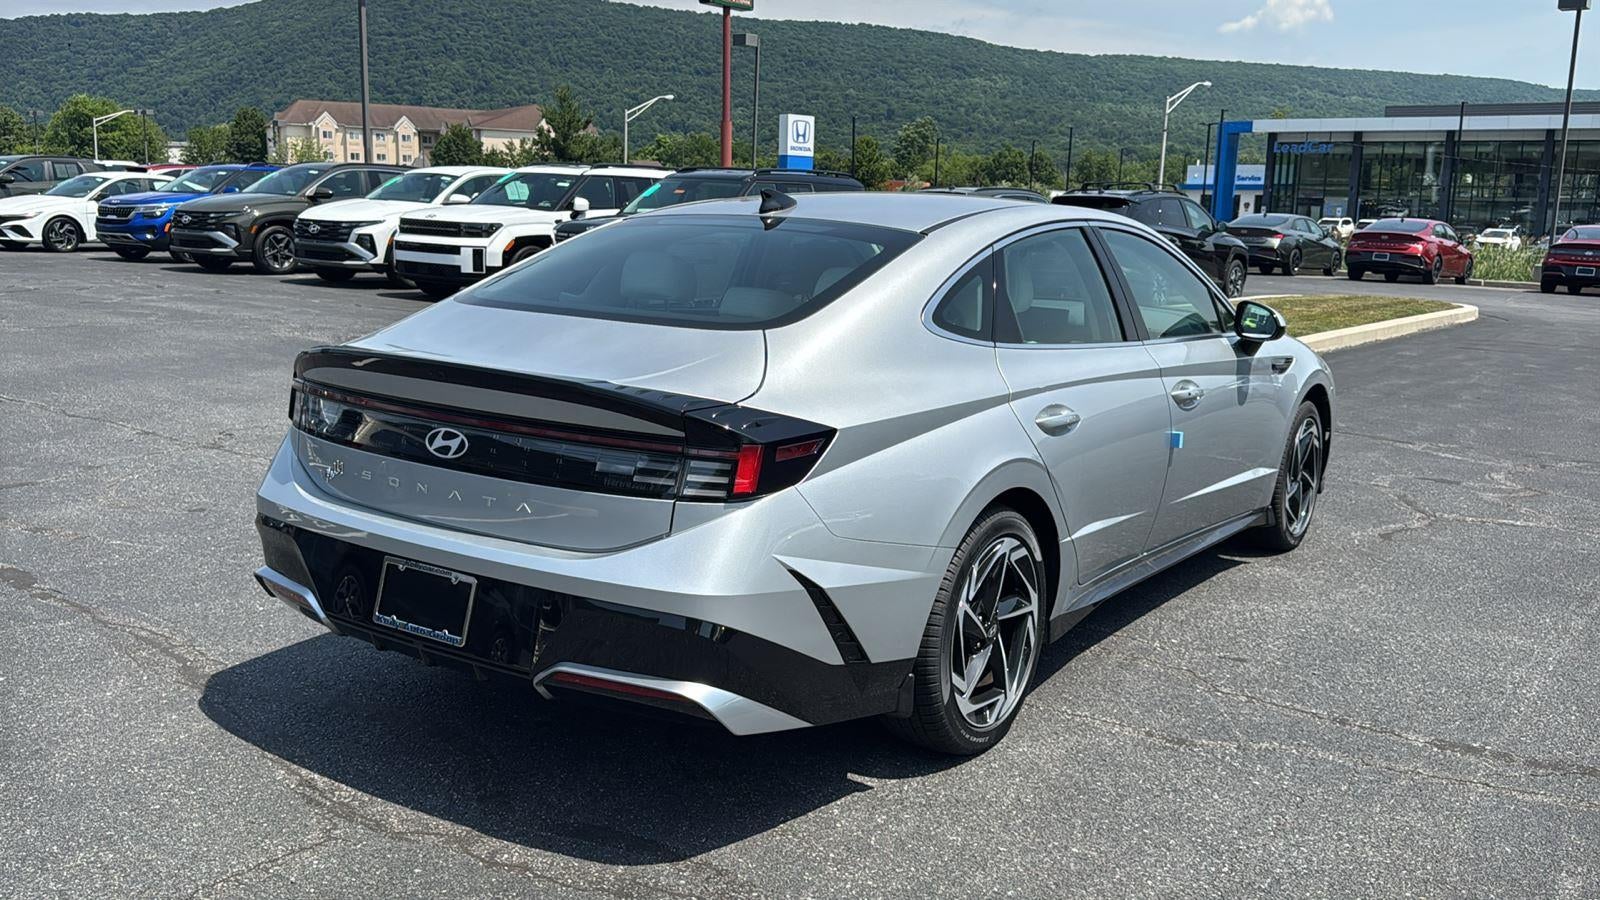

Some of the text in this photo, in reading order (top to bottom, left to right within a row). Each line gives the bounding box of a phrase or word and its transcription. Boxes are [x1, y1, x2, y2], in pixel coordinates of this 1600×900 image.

[1273, 141, 1334, 154] LeadCar
[1236, 174, 1262, 182] Service
[360, 469, 532, 515] SONATA
